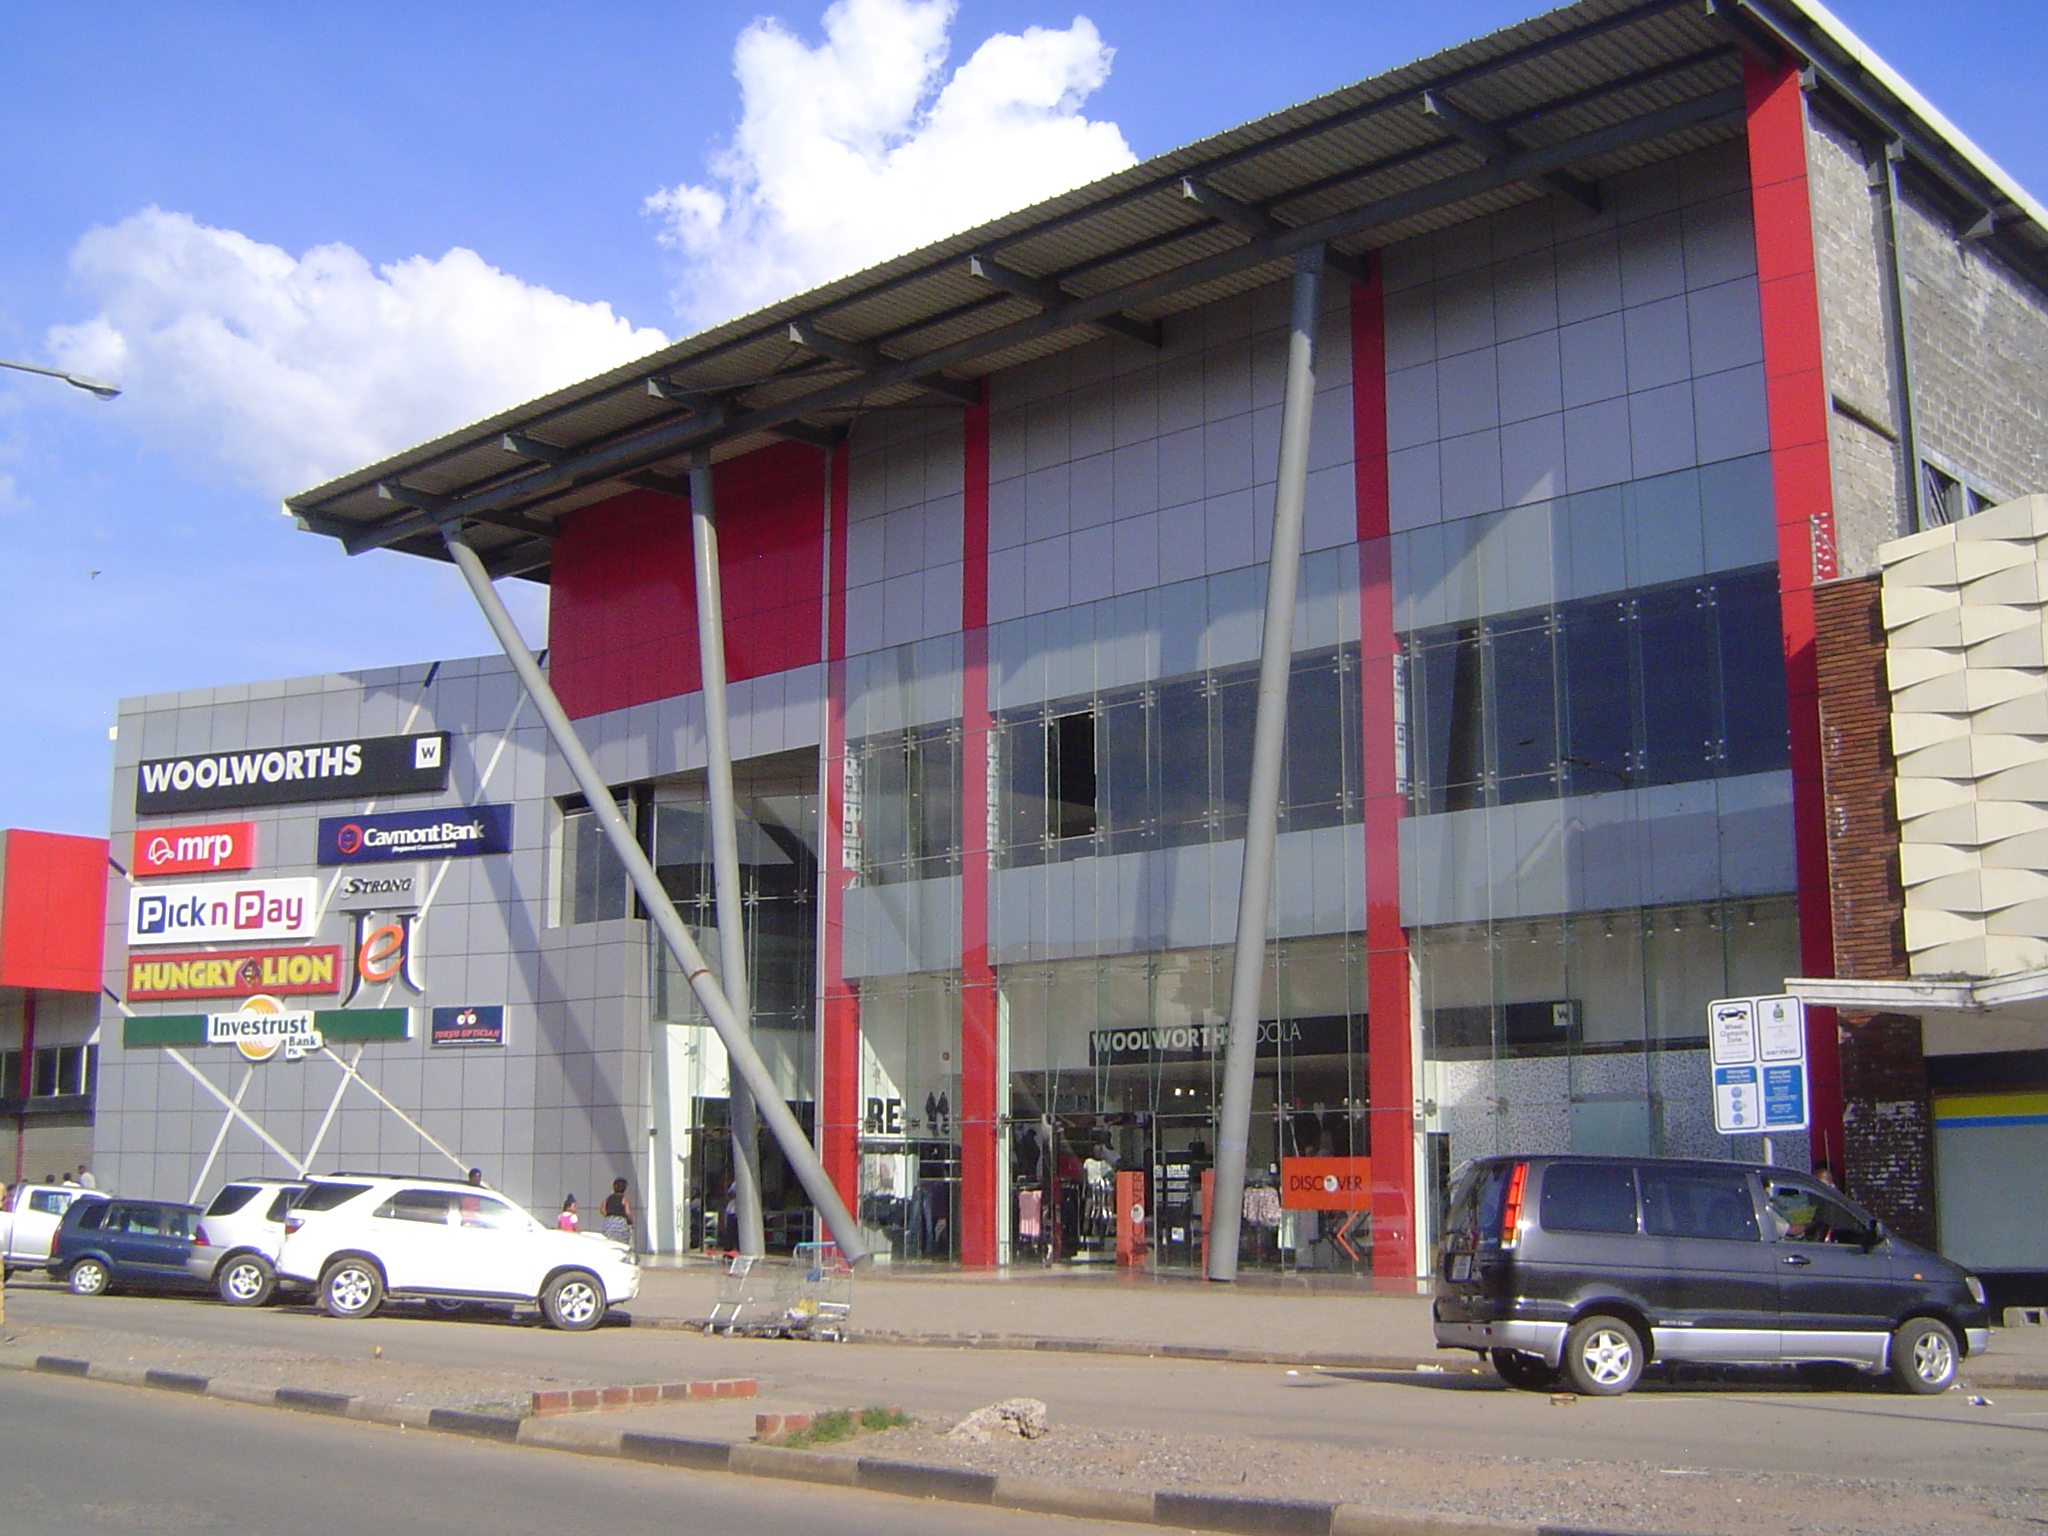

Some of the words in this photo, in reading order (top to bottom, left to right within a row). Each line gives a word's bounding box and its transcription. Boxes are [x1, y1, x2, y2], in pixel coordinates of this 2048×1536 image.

[420, 746, 437, 760] W
[142, 744, 362, 793] WOOLWORTHS
[363, 825, 440, 847] Cavmont
[441, 820, 485, 841] Bank
[177, 834, 233, 866] mrp
[137, 895, 206, 935] Pick
[211, 902, 228, 926] n
[234, 890, 303, 930] Pay
[132, 958, 245, 991] HUNGRY
[261, 953, 334, 985] LION
[213, 1015, 307, 1036] Investrust
[461, 1029, 501, 1038] OPTICIAN
[288, 1035, 317, 1047] Bank
